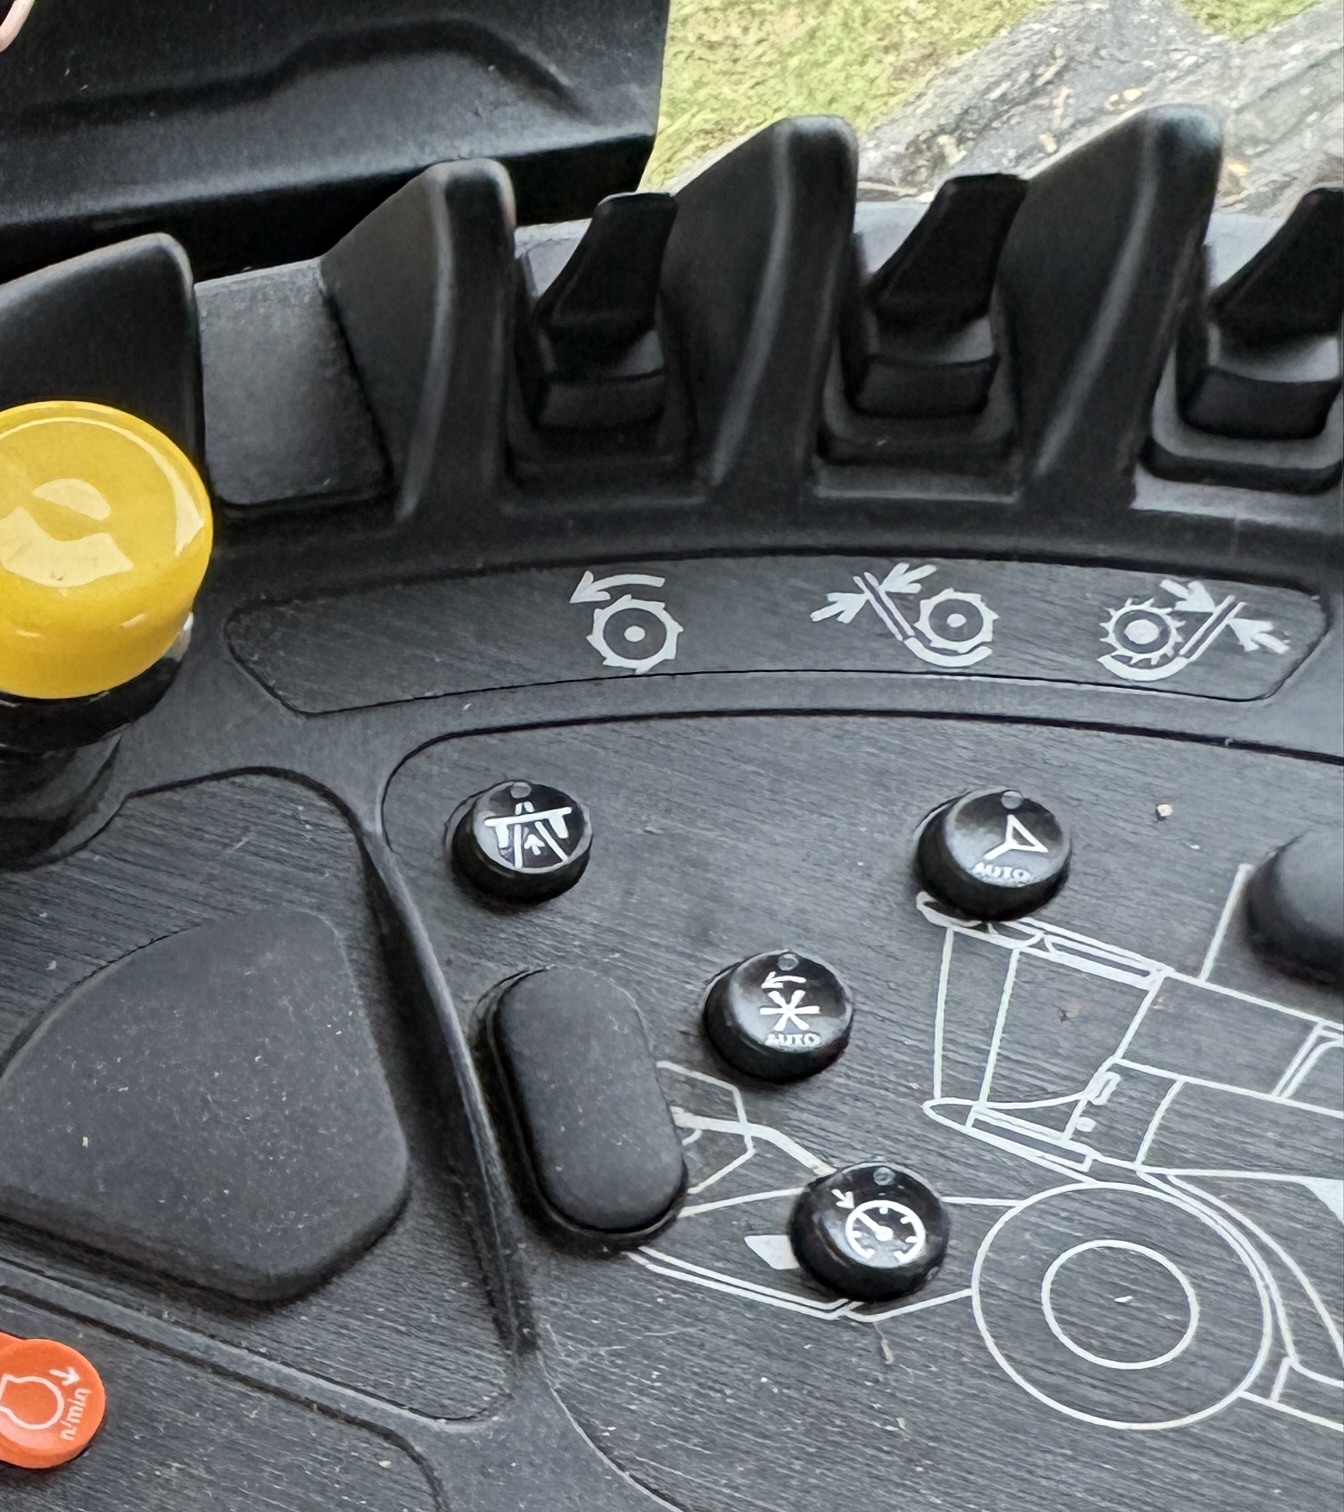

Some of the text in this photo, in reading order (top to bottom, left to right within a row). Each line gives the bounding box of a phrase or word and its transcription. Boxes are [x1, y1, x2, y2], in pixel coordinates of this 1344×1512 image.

[971, 861, 1032, 885] AUTO
[764, 1032, 821, 1050] AUTO
[59, 1386, 94, 1442] n/min
